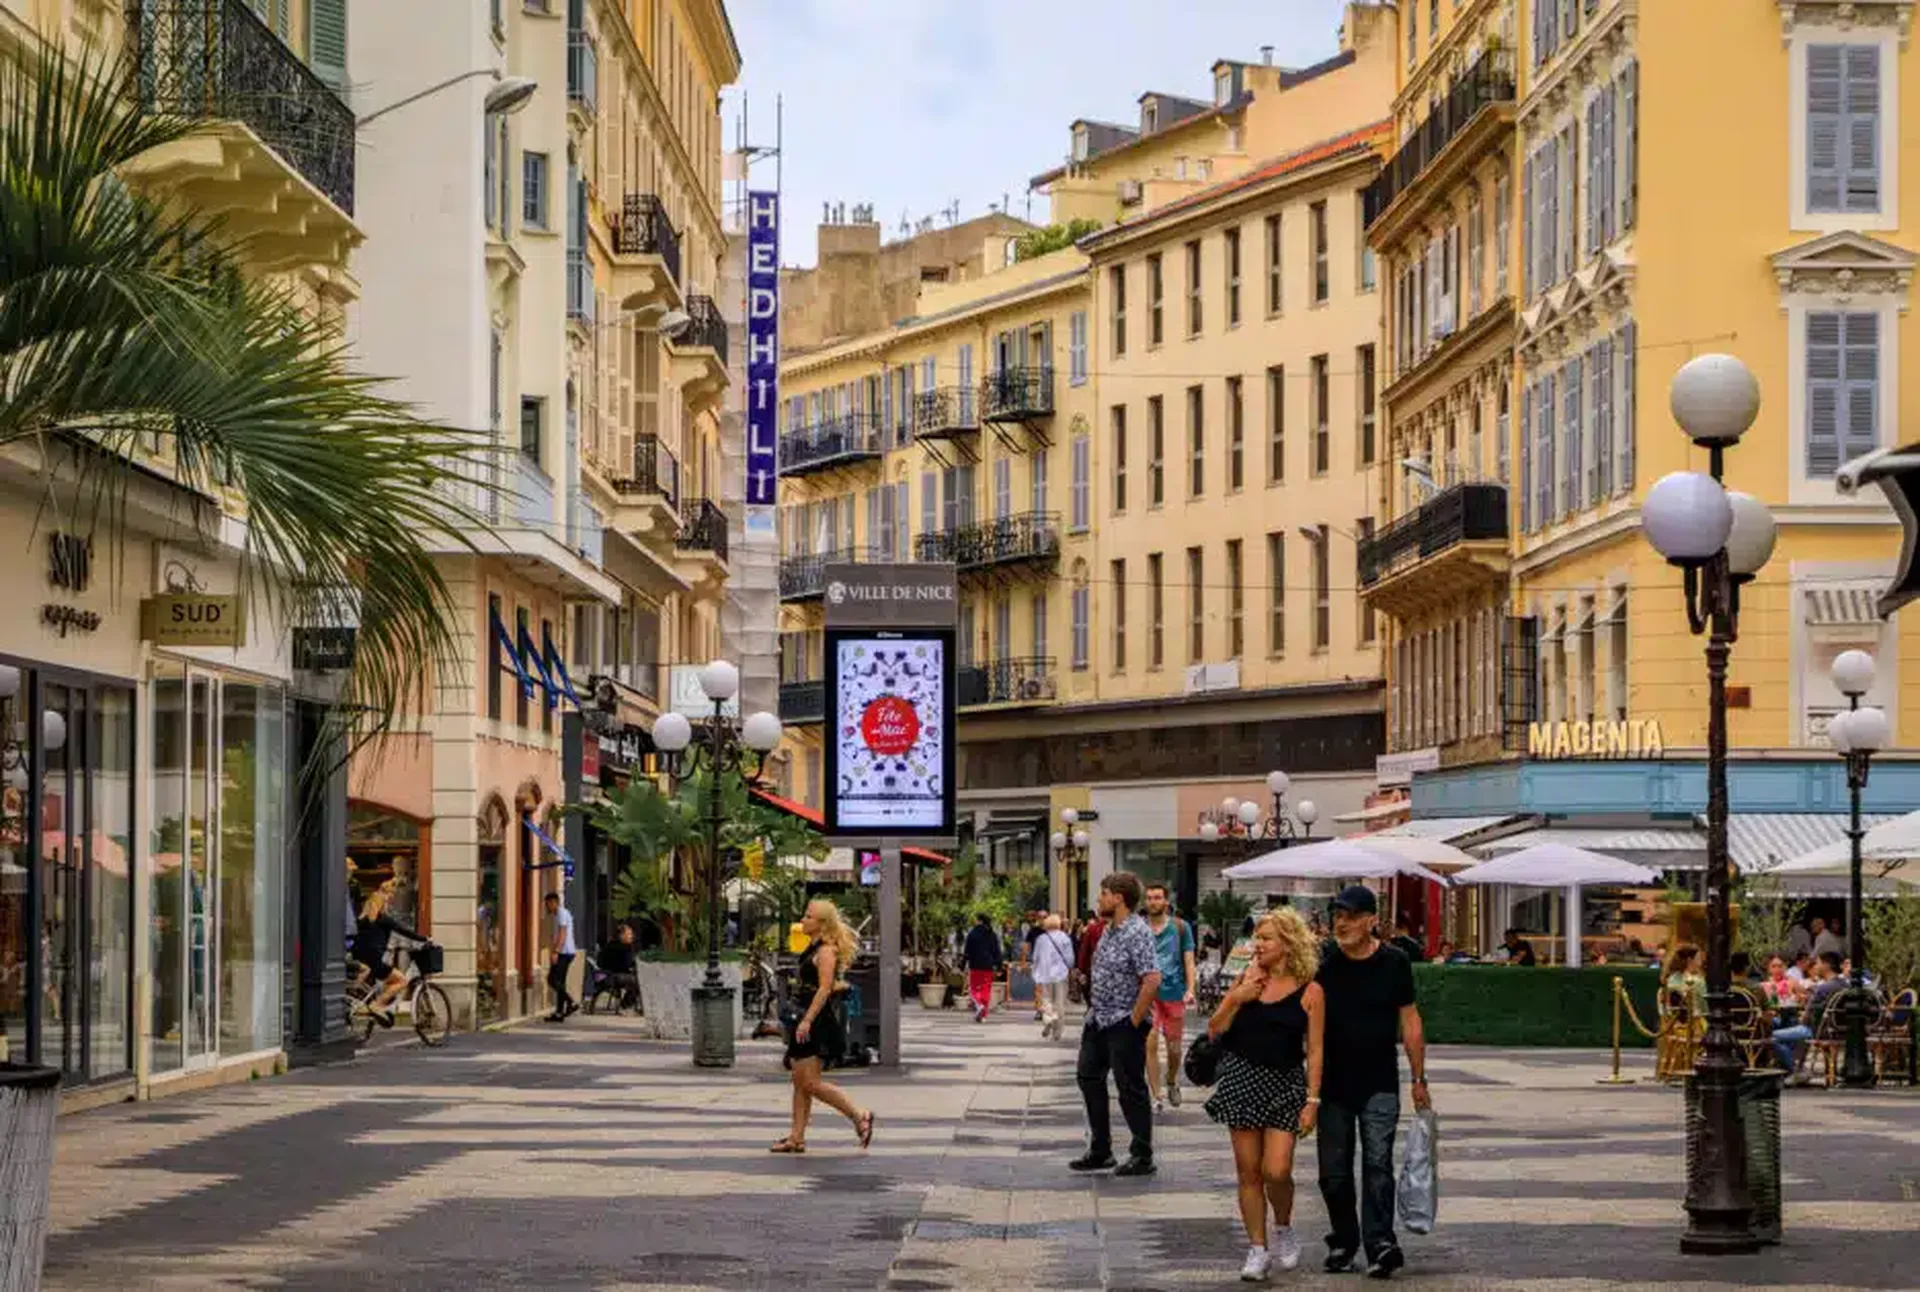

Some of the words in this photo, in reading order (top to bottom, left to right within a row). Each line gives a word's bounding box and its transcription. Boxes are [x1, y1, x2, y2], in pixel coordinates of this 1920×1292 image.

[750, 197, 776, 500] HEDHILI
[848, 586, 888, 600] VILLE
[892, 586, 913, 600] DE
[916, 586, 953, 600] NICE
[1529, 720, 1663, 758] MAGENTA
